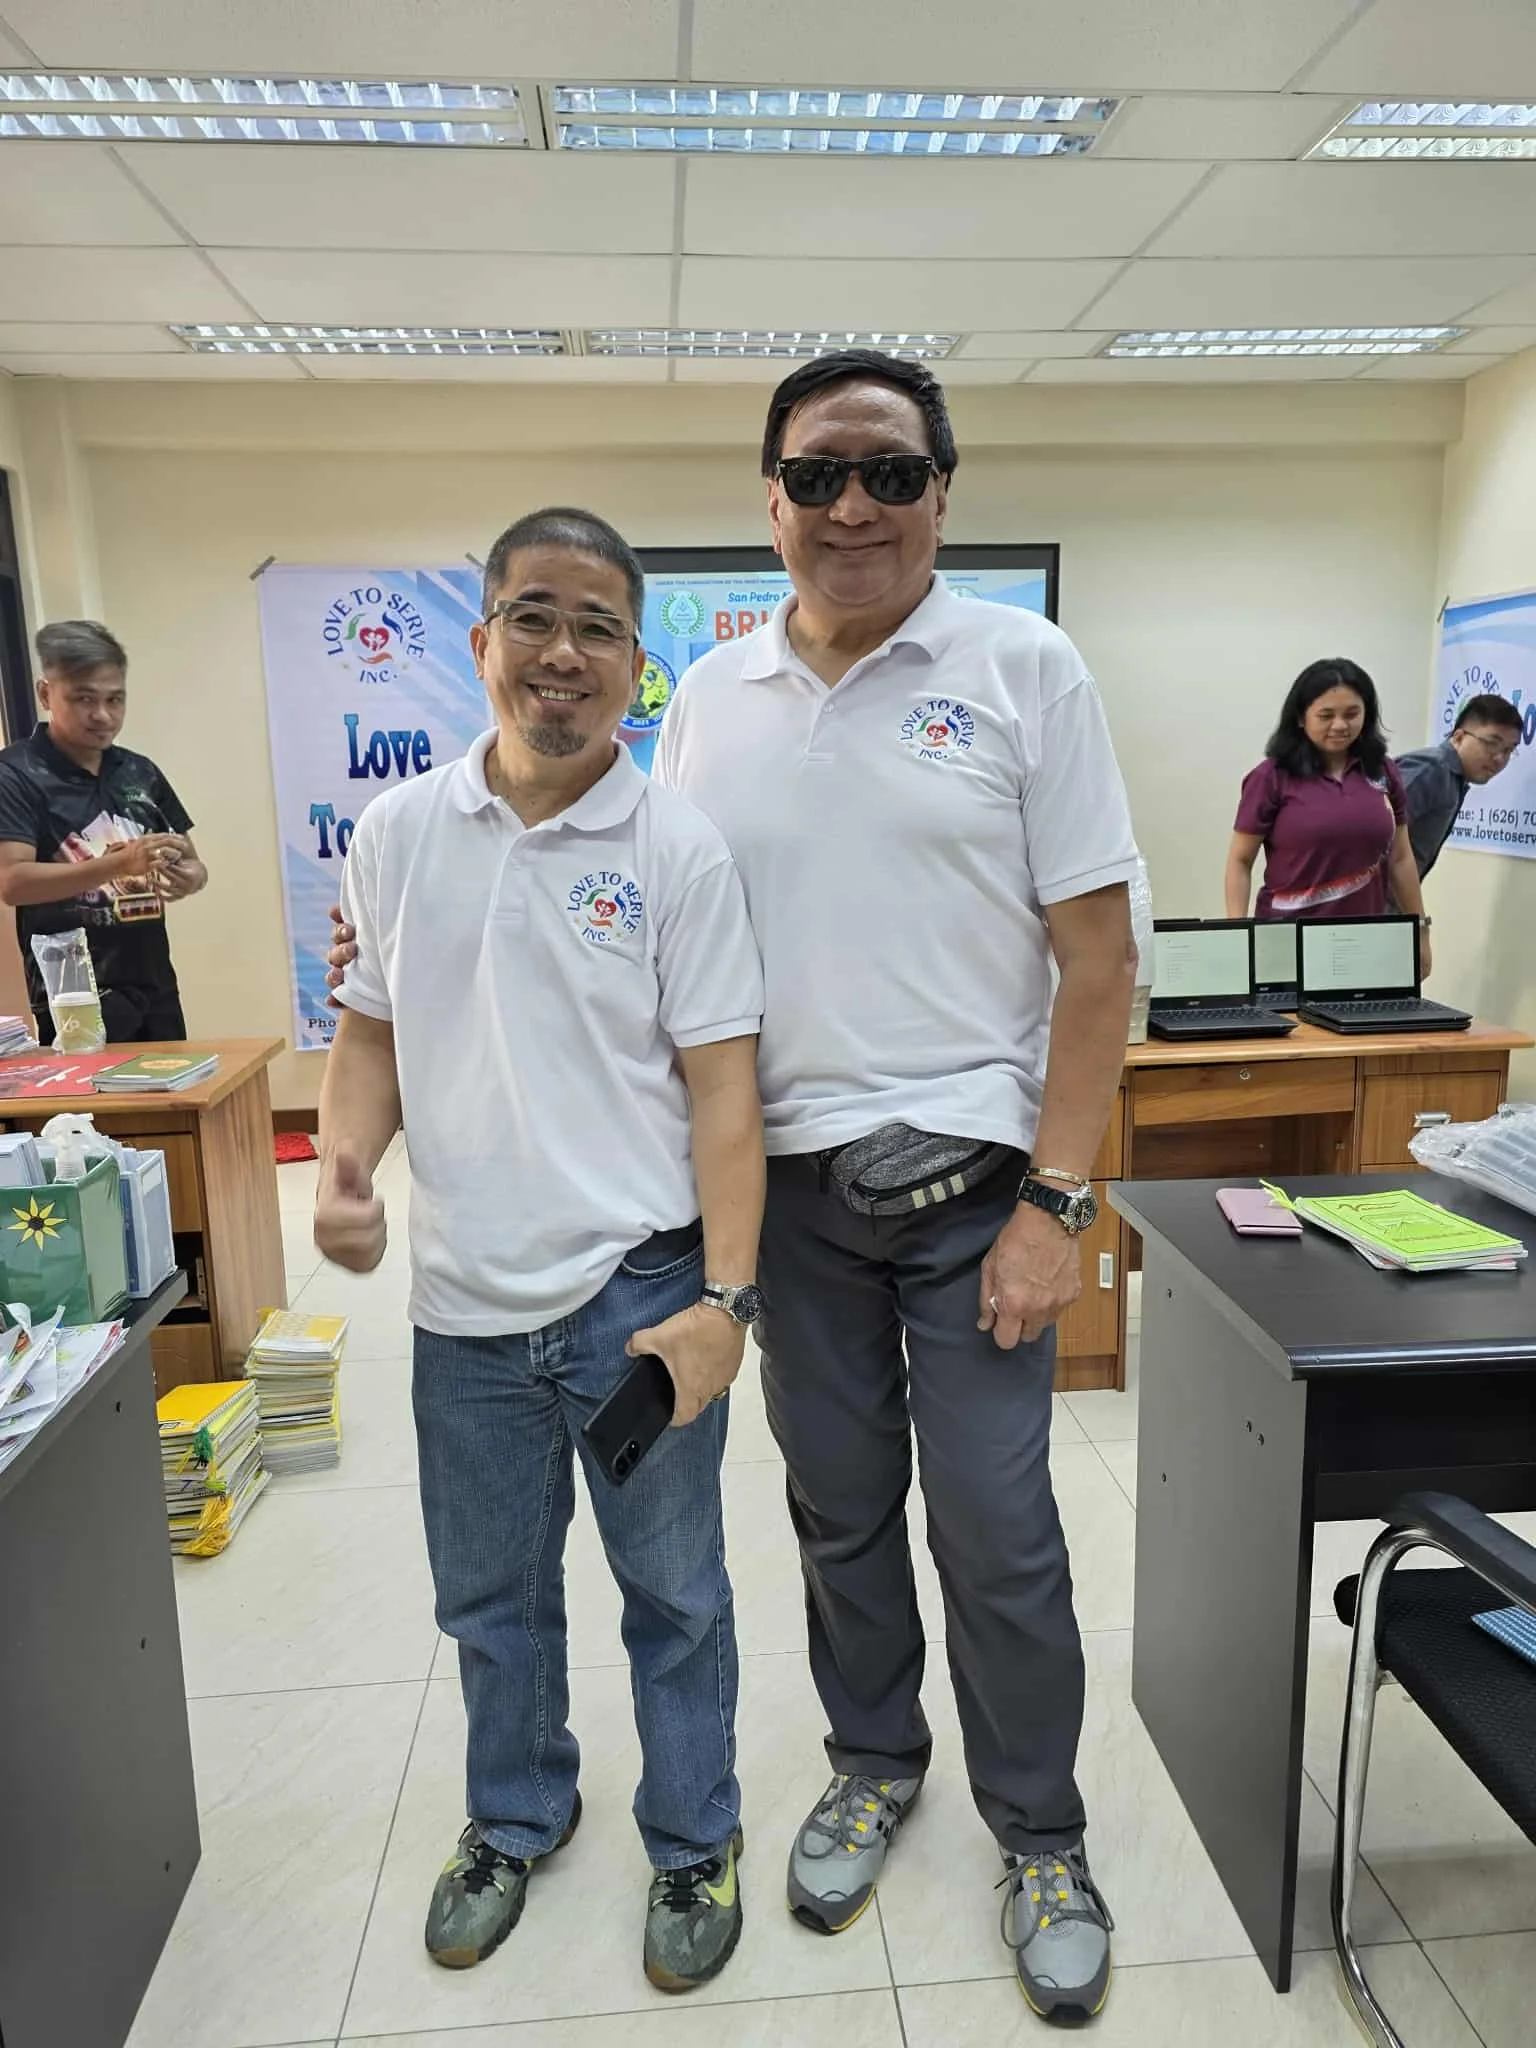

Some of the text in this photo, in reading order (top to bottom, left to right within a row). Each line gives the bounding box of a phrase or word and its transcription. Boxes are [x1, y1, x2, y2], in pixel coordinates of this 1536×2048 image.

[728, 591, 748, 603] San
[750, 590, 780, 602] Pedro
[323, 587, 426, 659] LOVE TO SERVE
[359, 669, 399, 684] INC.
[1464, 664, 1481, 685] TO
[900, 698, 976, 750] LOVE TO SERVE
[344, 713, 432, 780] Love
[918, 748, 949, 760] INC.
[1479, 807, 1485, 822] 1
[1488, 808, 1519, 829] (626)
[309, 803, 356, 859] To
[567, 871, 644, 934] LOVE TO SERVE
[581, 926, 612, 943] INC.
